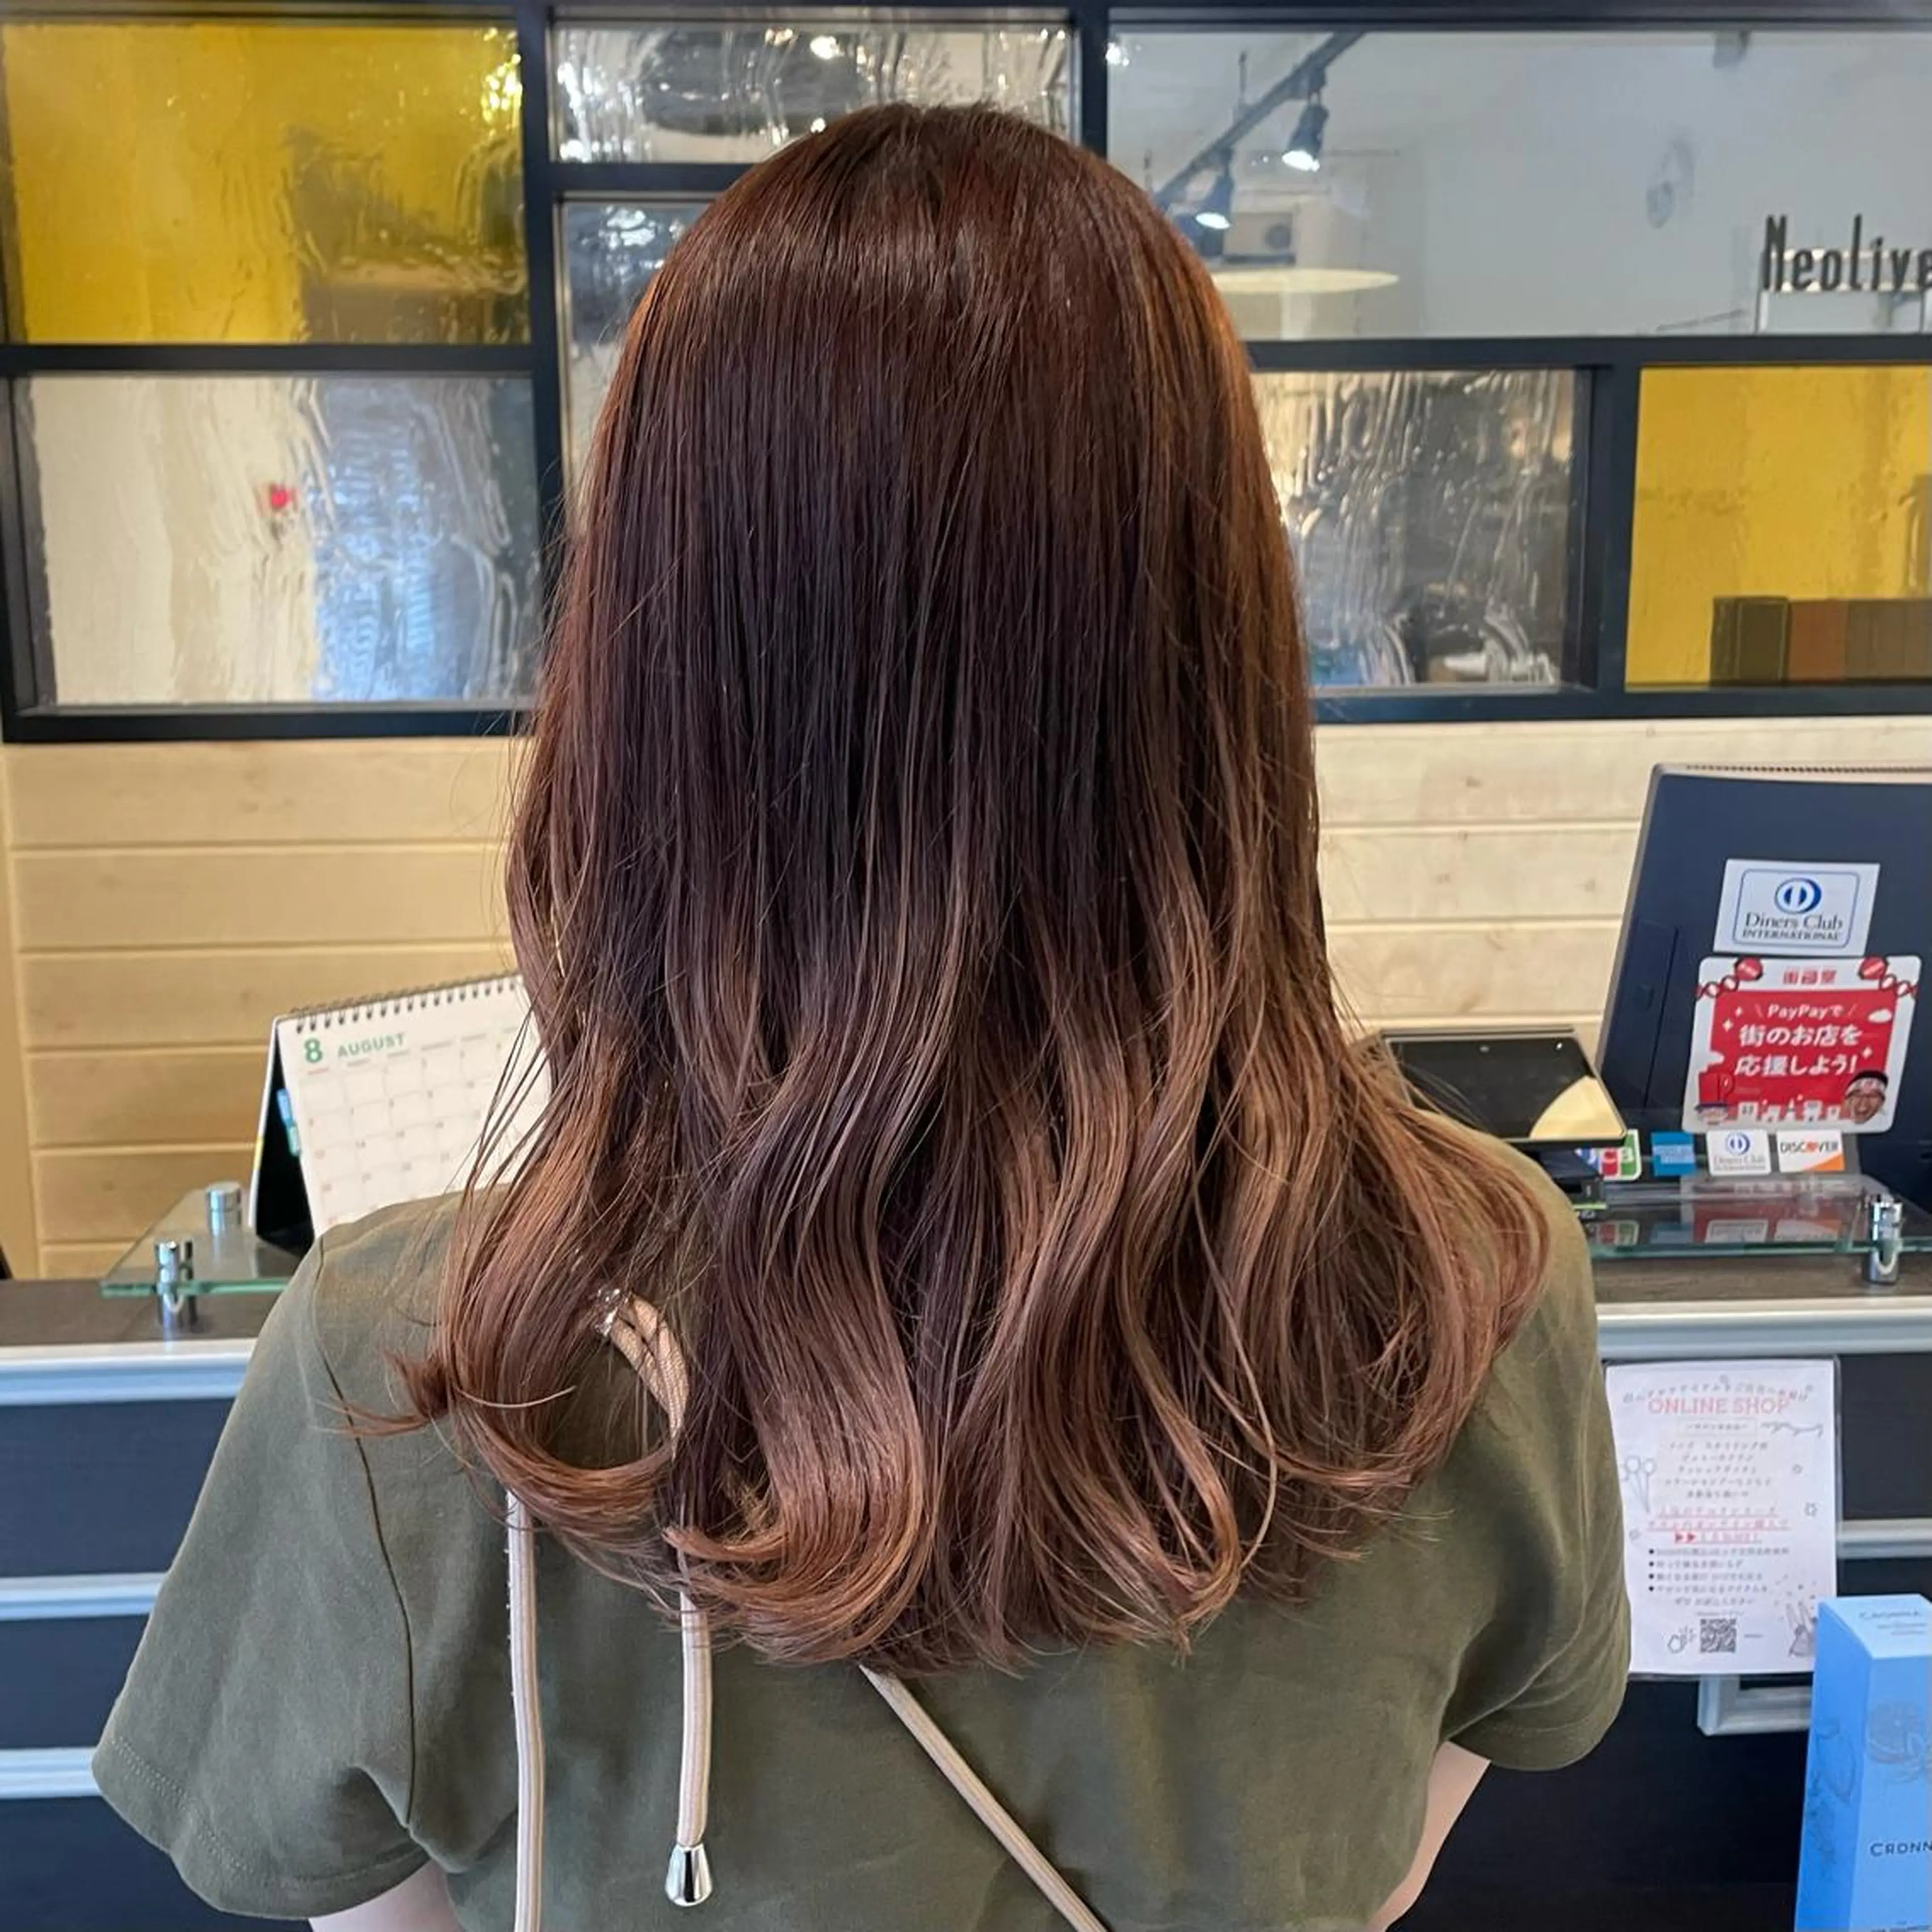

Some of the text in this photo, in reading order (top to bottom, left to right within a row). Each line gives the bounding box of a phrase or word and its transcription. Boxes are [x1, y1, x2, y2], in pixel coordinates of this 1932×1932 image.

[1762, 214, 1932, 292] Neolive
[1745, 912, 1842, 929] Diners Club
[1742, 930, 1840, 940] INTERNATIONAL
[1740, 1024, 1863, 1047] 街のお店を
[304, 1032, 406, 1064] 8 AUGUST
[1780, 1141, 1838, 1153] DISCOVER
[1648, 1397, 1729, 1415] ONLINE
[1732, 1396, 1791, 1415] SHOP
